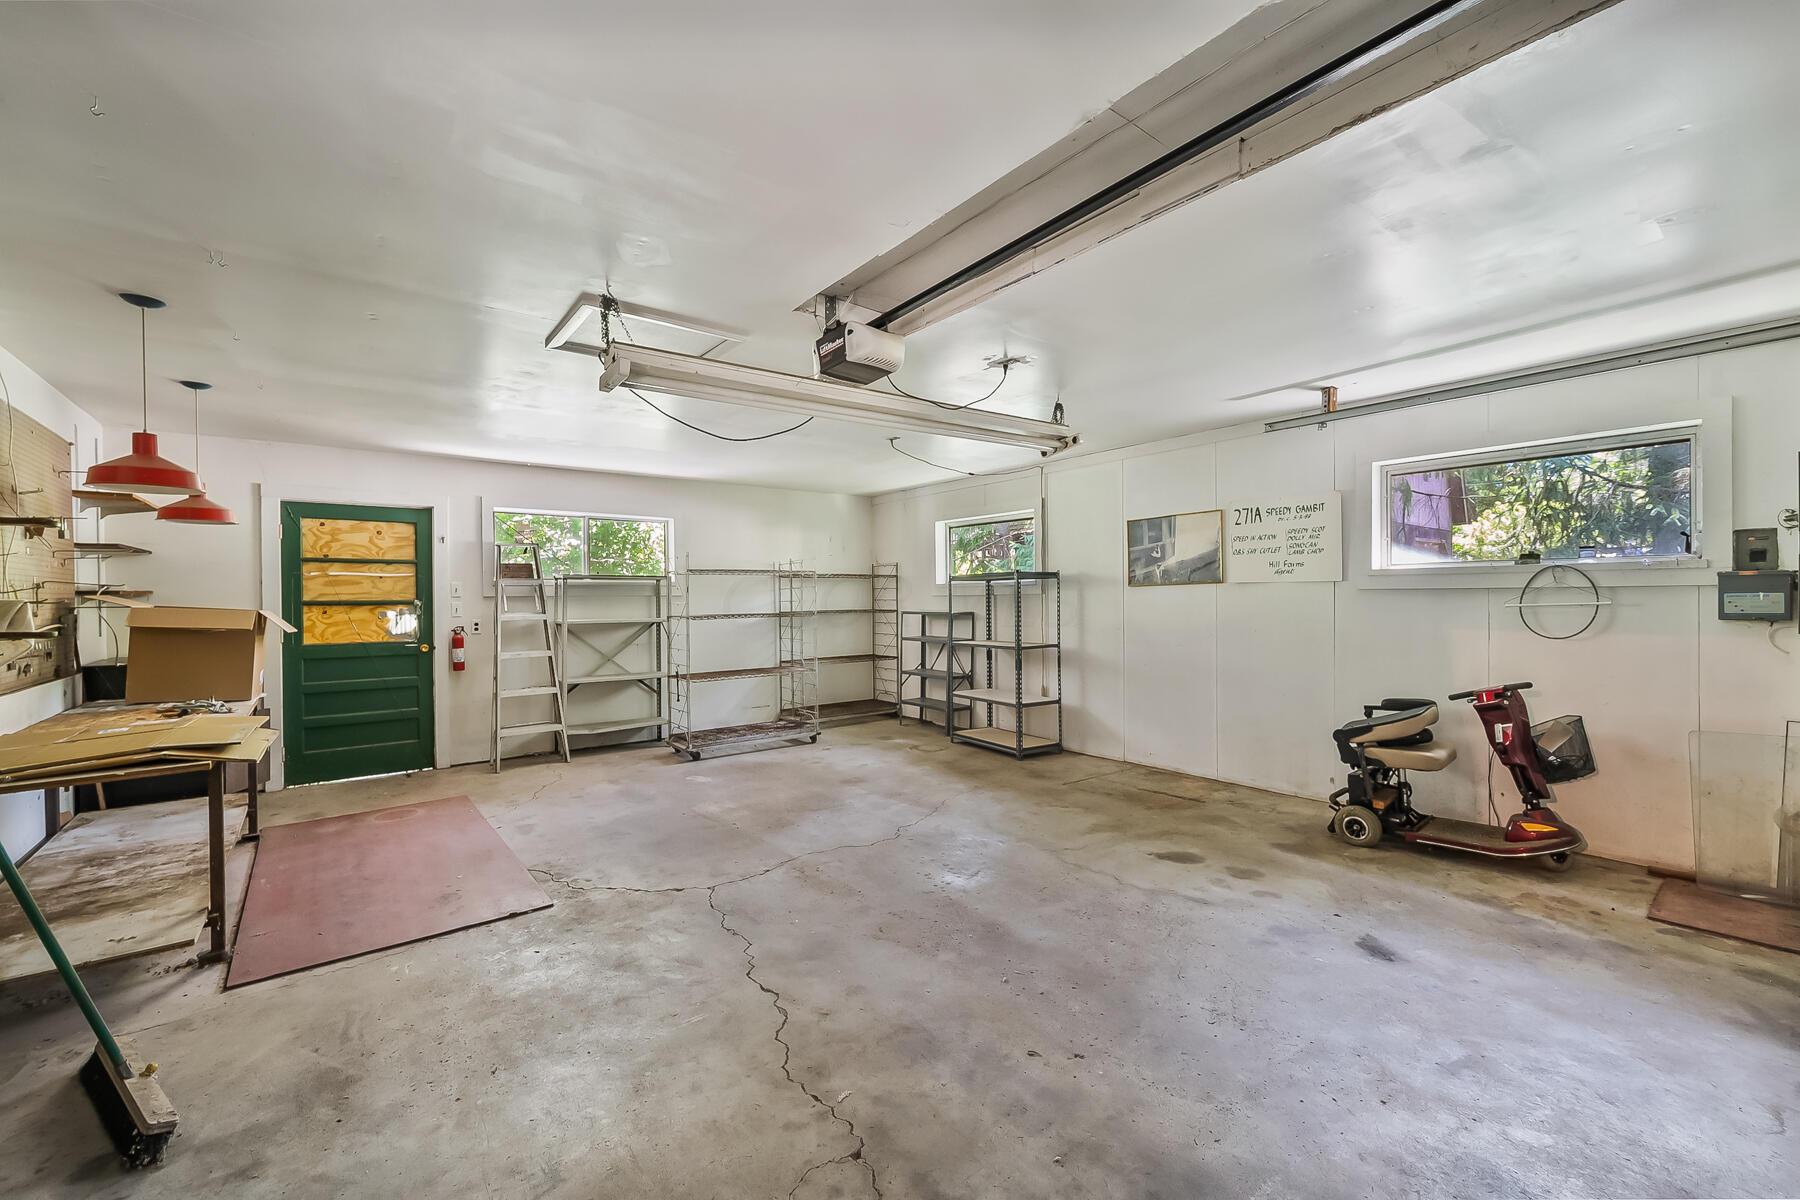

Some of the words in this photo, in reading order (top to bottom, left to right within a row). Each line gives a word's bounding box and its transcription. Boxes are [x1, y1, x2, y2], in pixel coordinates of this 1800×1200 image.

[1233, 506, 1262, 526] 271A
[1265, 506, 1292, 517] SPEEDY
[1295, 502, 1325, 514] GAMBIT
[1232, 535, 1249, 543] SPEED
[1256, 533, 1278, 541] ACTION
[1268, 560, 1280, 568] Hill
[1283, 559, 1305, 568] Farms
